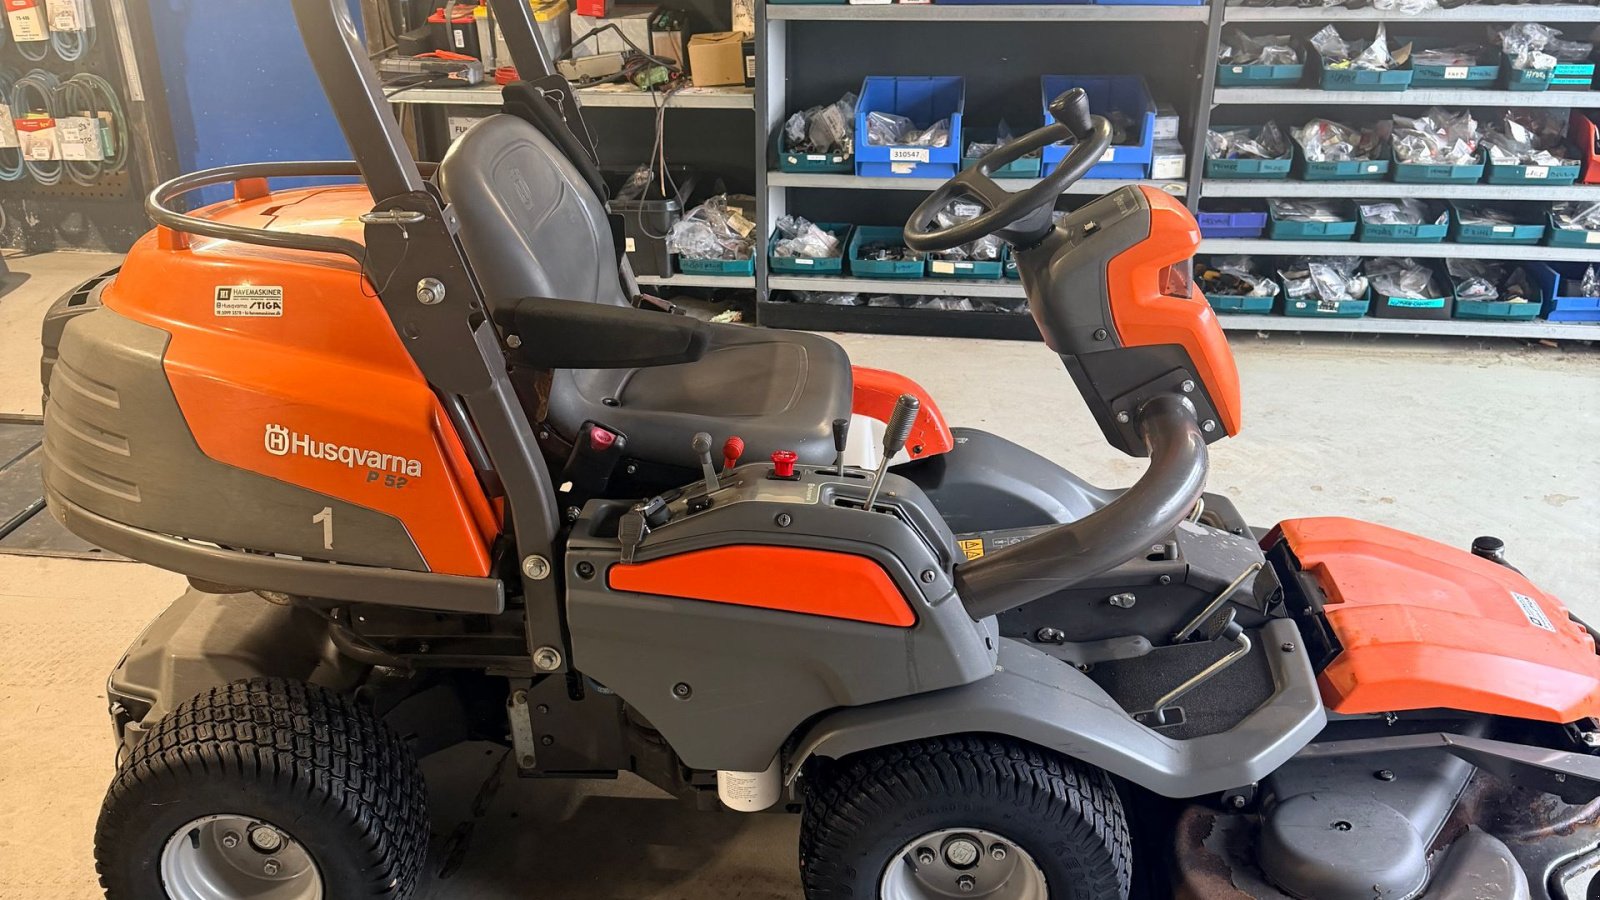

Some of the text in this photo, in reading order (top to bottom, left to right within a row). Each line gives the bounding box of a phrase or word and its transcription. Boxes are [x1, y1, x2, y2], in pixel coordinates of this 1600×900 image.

[291, 432, 422, 478] Husqvarna
[366, 470, 409, 489] P 52
[312, 506, 334, 550] 1
